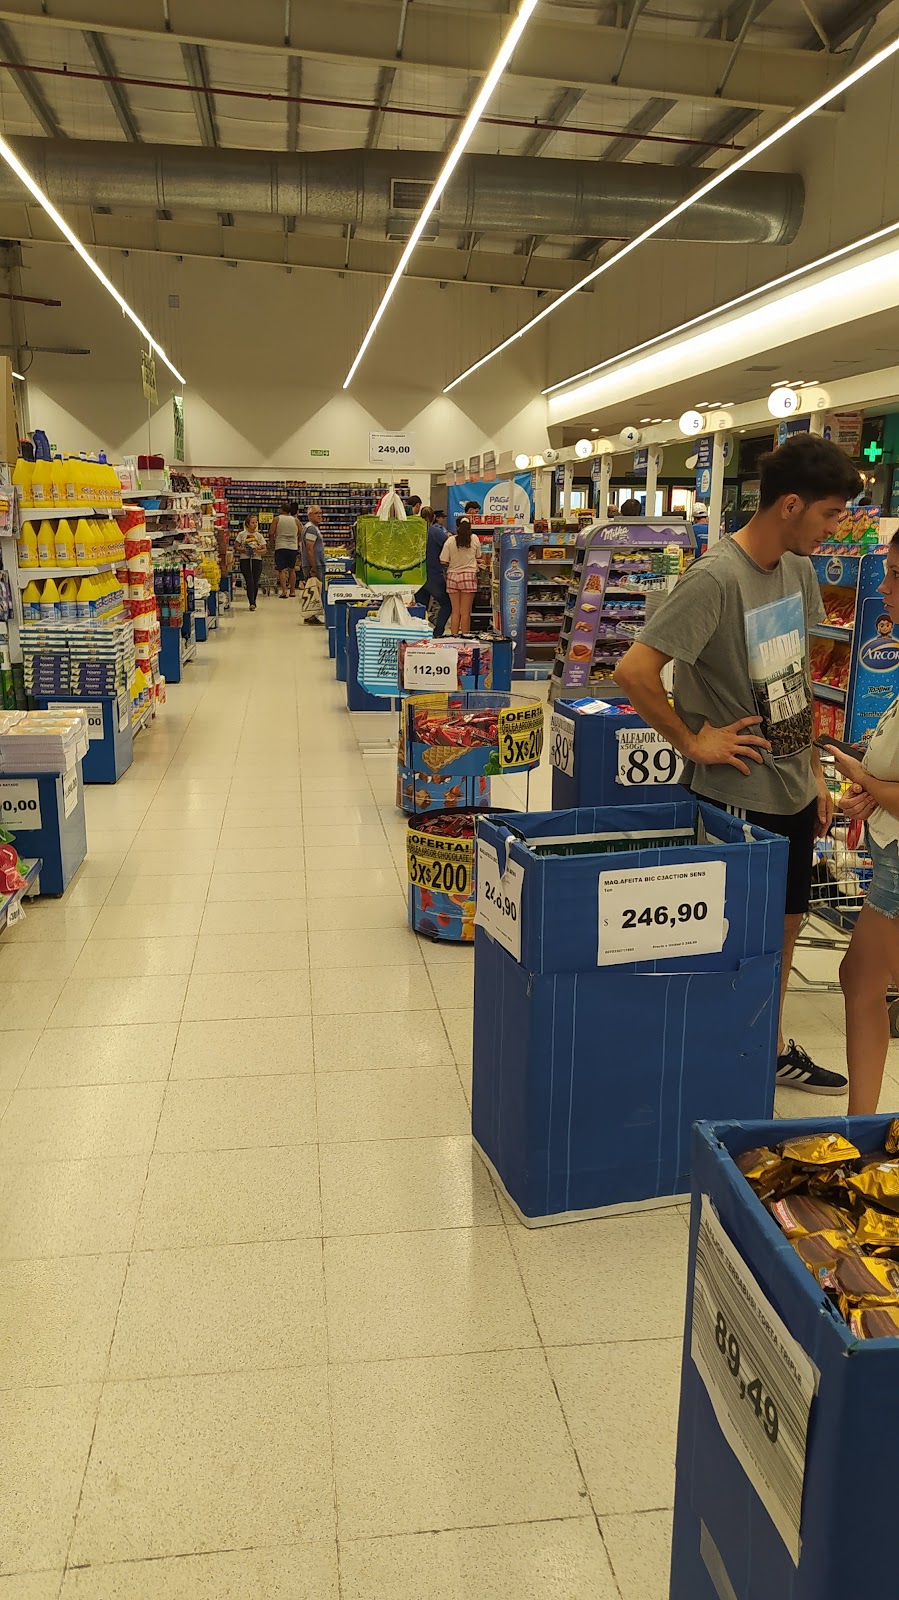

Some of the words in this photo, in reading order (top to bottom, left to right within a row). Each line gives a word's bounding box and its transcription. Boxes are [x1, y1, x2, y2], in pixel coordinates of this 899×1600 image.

[784, 398, 792, 408] 6
[693, 420, 699, 428] 5
[627, 432, 634, 440] 4
[378, 446, 410, 454] 249,00
[722, 442, 729, 458] 5
[600, 526, 629, 540] Milka
[413, 665, 450, 676] 112,90
[620, 732, 656, 744] ALFAJOR
[620, 765, 626, 775] $
[627, 748, 676, 784] 89
[409, 836, 470, 852] ¡OFERTA!
[604, 878, 643, 886] MAQ.AFEITA
[656, 873, 688, 881] C3ACTION
[604, 918, 609, 927] $
[621, 901, 708, 929] 246,90
[757, 1310, 778, 1344] TORTA
[715, 1311, 779, 1444] 89,49
